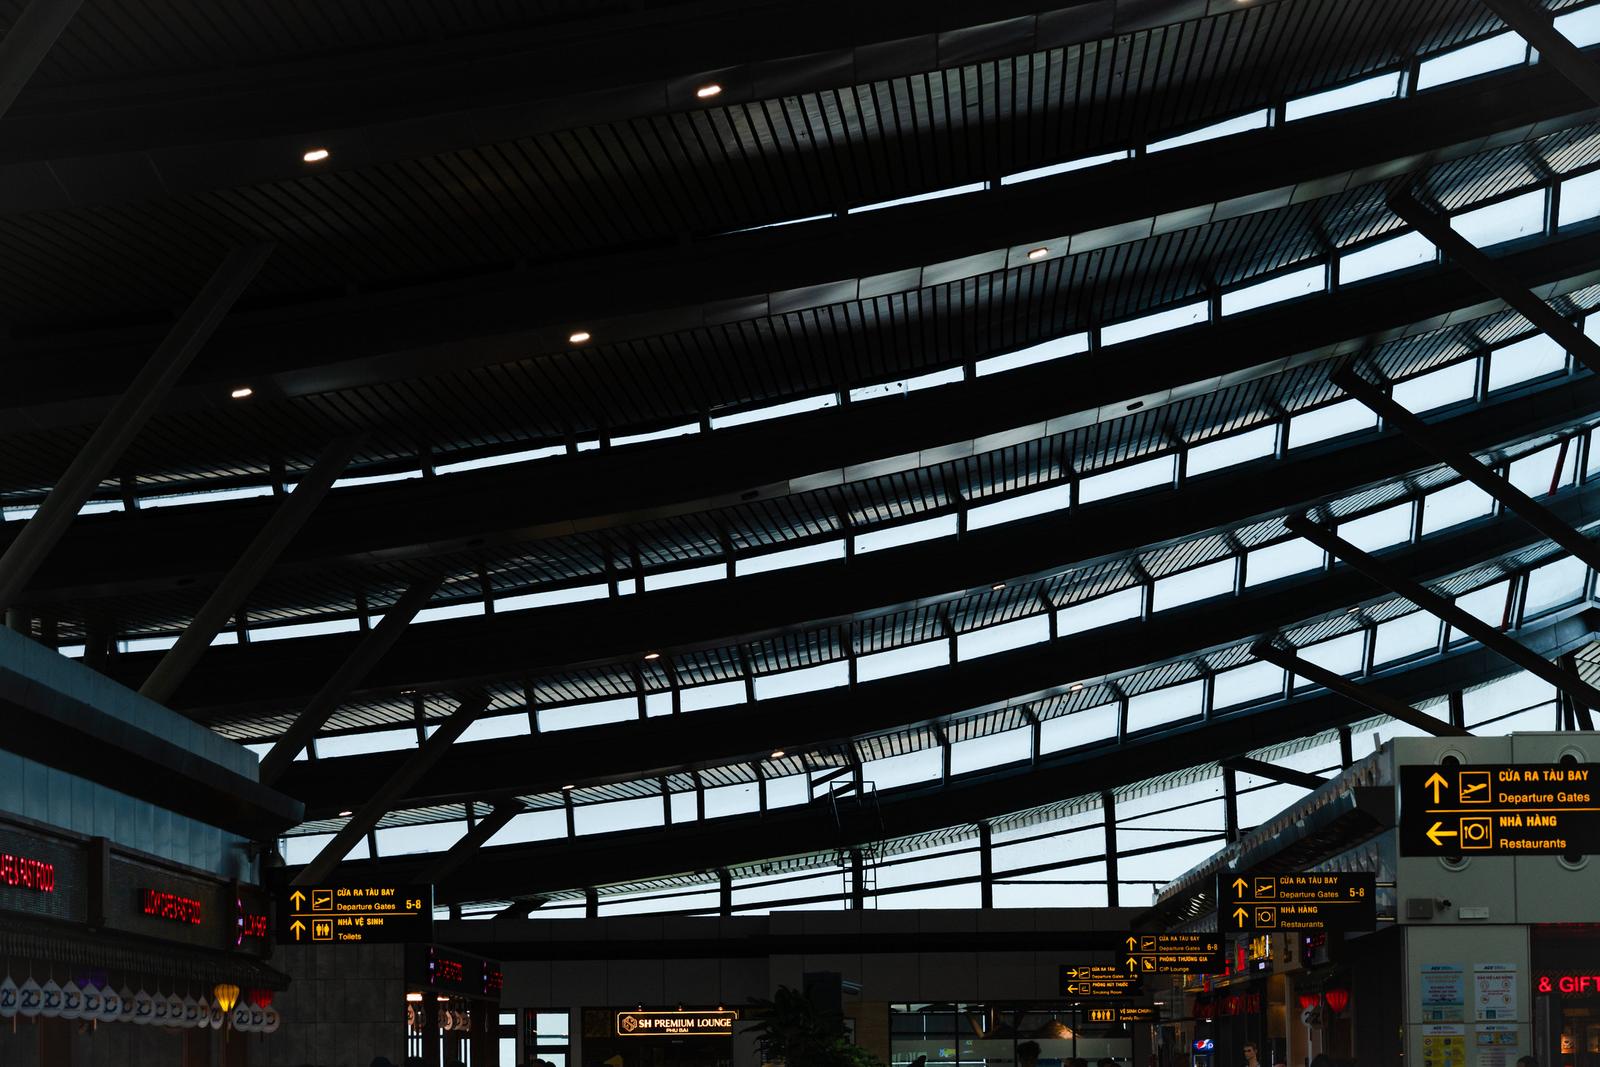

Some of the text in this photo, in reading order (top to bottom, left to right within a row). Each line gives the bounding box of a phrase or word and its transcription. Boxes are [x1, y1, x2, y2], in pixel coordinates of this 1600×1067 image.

[1498, 768, 1589, 782] CỬA RA TÀU BAY
[1498, 791, 1590, 805] Departure Gates
[1499, 813, 1558, 827] NHÀ HÀNG
[1499, 838, 1567, 849] Restaurants
[1309, 876, 1322, 884] TÀU
[337, 888, 351, 896] CỬA
[365, 887, 379, 896] TÀU
[381, 888, 395, 896] BAY
[1280, 887, 1365, 899] Departure Gates 5-8
[406, 899, 421, 909] 5-8
[1280, 905, 1318, 914] NHÀ HÀNG
[337, 917, 352, 926] NHÀ
[354, 917, 364, 927] VỆ
[1538, 976, 1551, 993] &
[639, 1018, 732, 1028] SH PREMIUM LOUNGE
